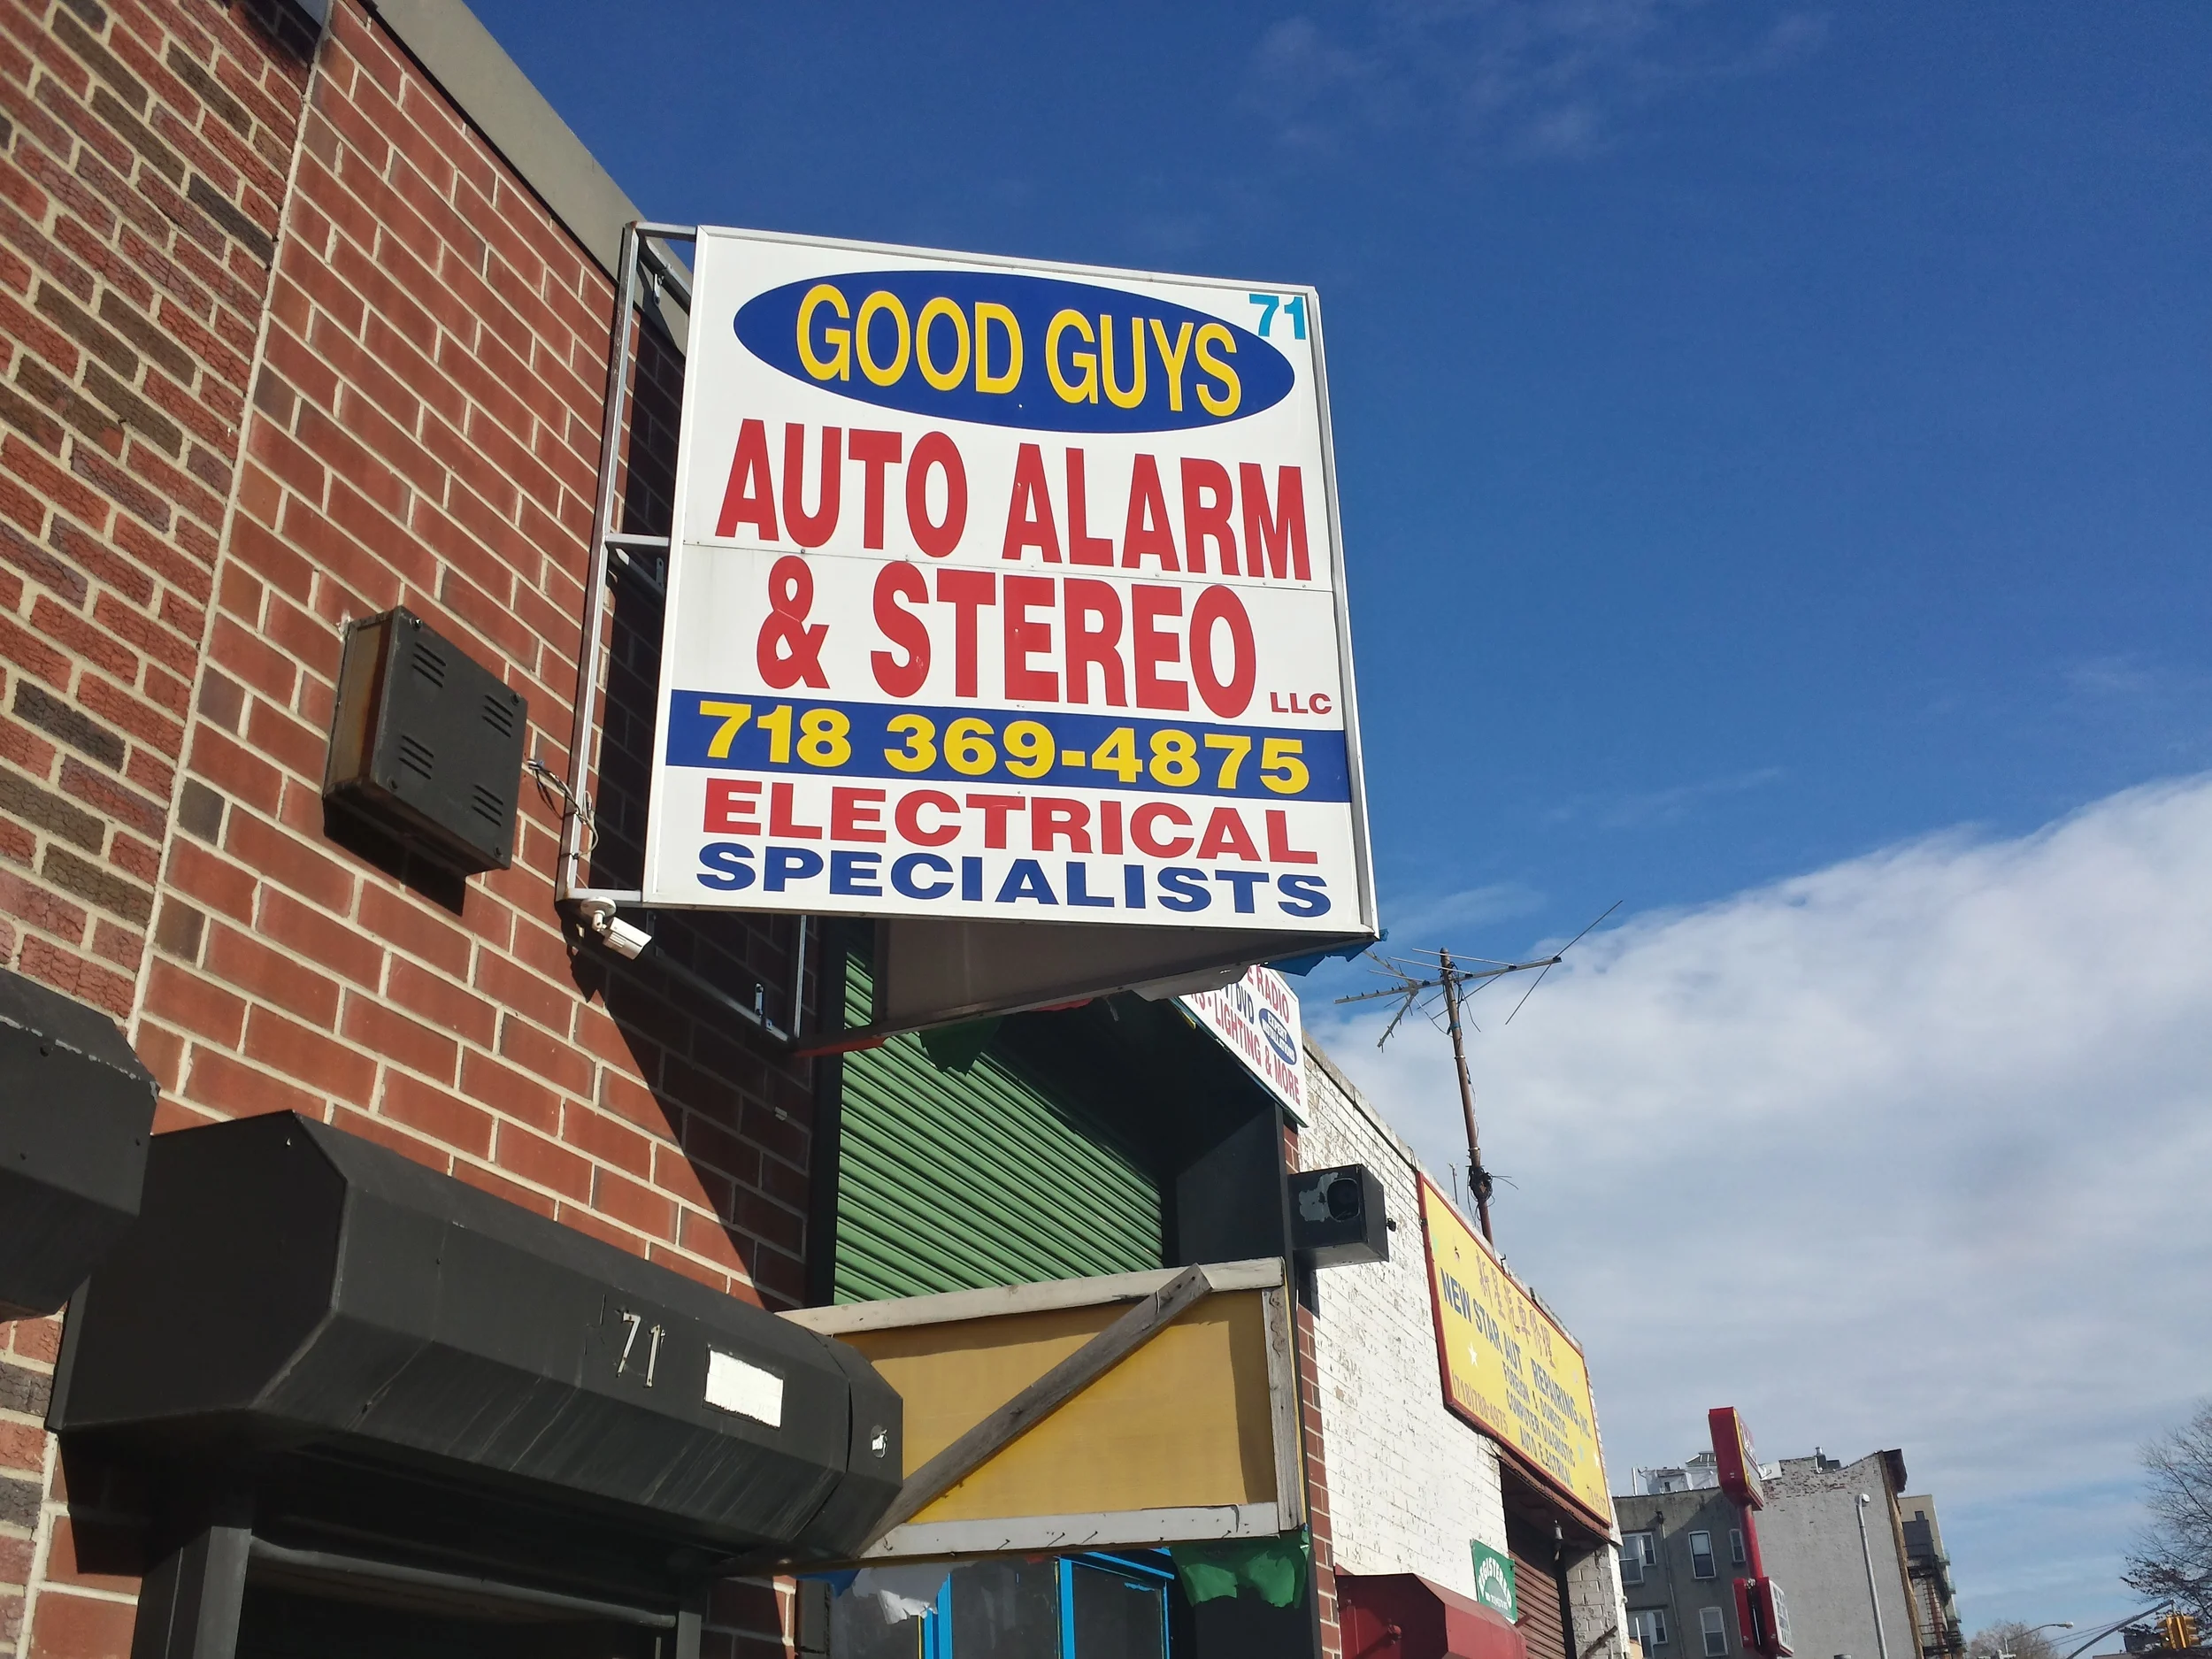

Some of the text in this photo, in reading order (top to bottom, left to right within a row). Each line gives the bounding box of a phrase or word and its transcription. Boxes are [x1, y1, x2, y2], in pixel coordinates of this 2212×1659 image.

[796, 284, 1241, 417] GOOD GUYS
[1248, 293, 1307, 341] 71
[715, 419, 1311, 581] AUTO ALARM
[757, 555, 1256, 718] & STEREO
[1270, 692, 1333, 715] LLC
[699, 701, 1310, 795] 718 369-4875
[703, 778, 1318, 864] ELECTRICAL
[697, 842, 1332, 918] SPECIALISTS
[1256, 965, 1289, 1024] RADIO
[1214, 992, 1301, 1106] LIGHTING & MORE
[618, 1311, 661, 1388] 71
[1440, 1266, 1472, 1325] NEW
[1472, 1297, 1502, 1355] STAR
[1506, 1387, 1540, 1438] COMPUTER
[1519, 1425, 1538, 1459] AUTO
